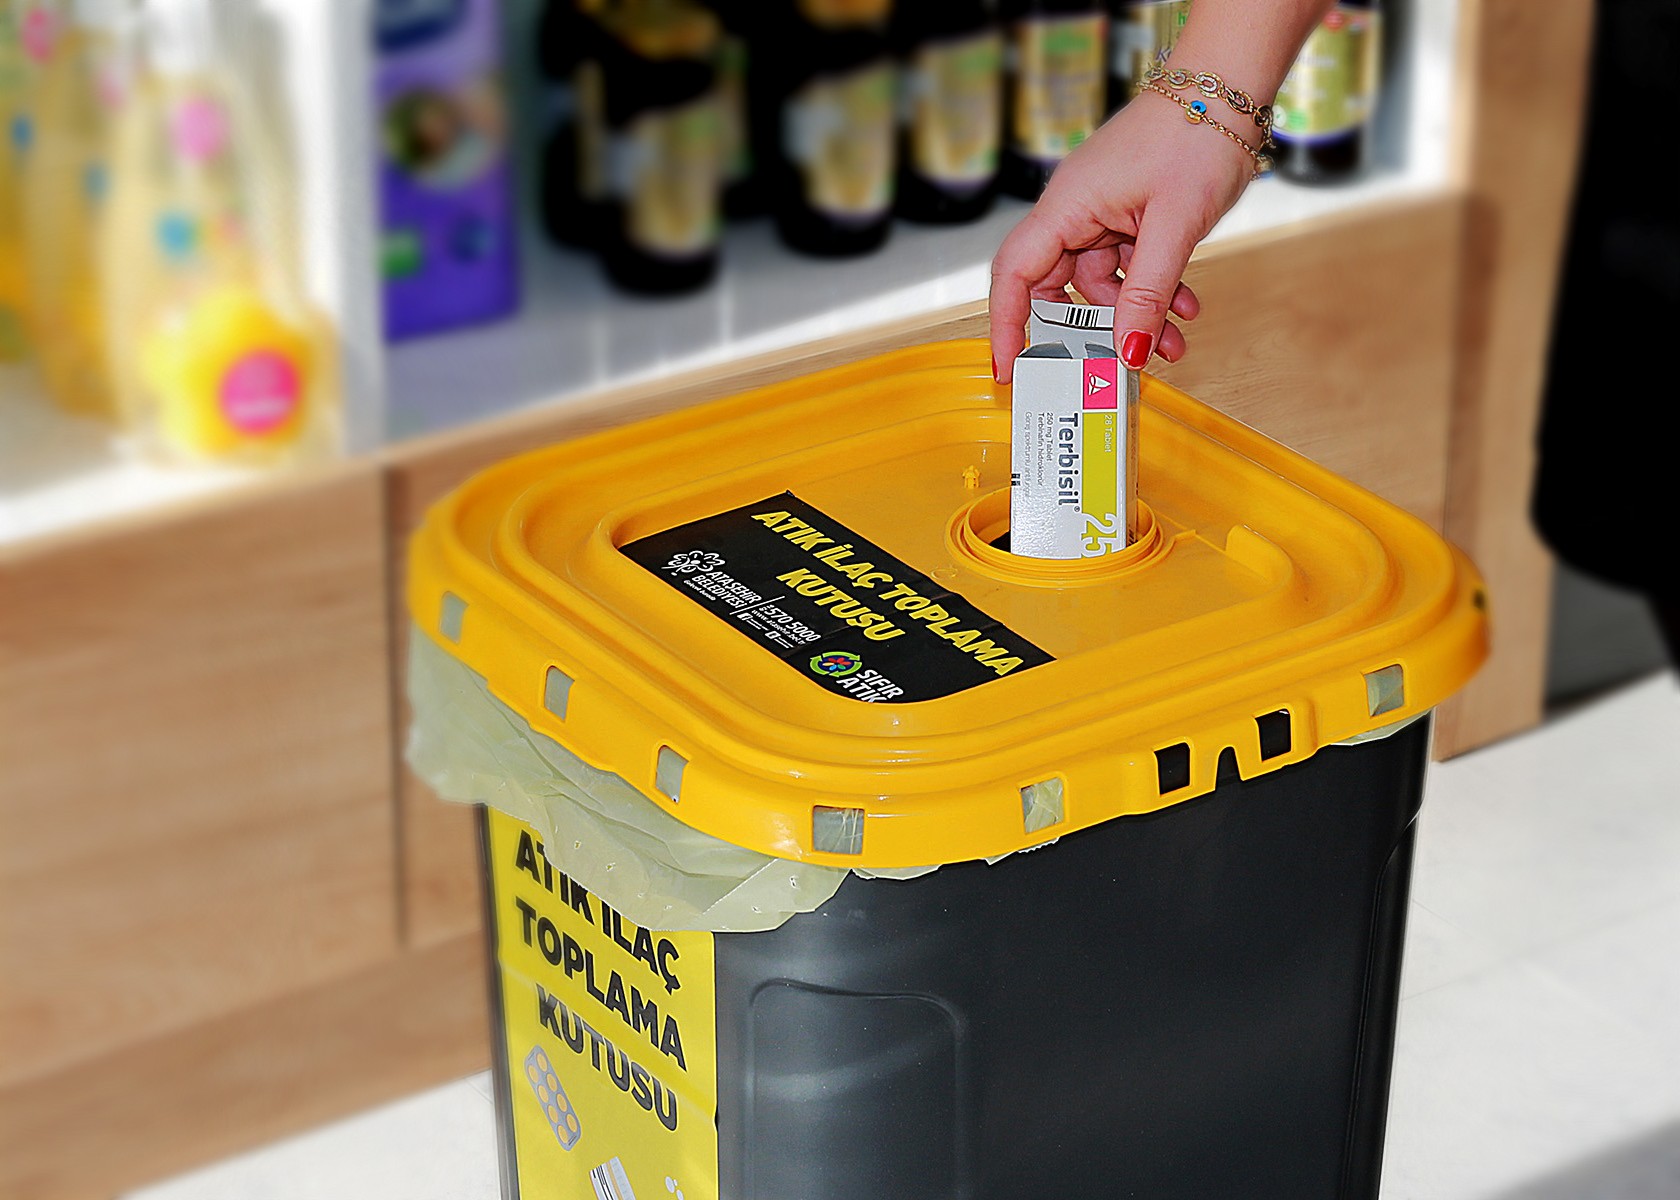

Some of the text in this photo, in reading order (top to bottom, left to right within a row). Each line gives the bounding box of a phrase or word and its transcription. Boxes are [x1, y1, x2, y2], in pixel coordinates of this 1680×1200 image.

[1104, 428, 1113, 453] Tablet
[751, 510, 1024, 676] ATIK İLAÇ TOPLAMA
[764, 607, 794, 623] 570
[785, 621, 821, 642] 5000
[776, 568, 906, 641] KUTUSU
[836, 677, 887, 703] ATIK
[856, 669, 904, 699] SIFIR
[515, 829, 595, 926] ATIK
[515, 895, 687, 1072] TOPLAMA
[536, 982, 678, 1131] KUTUSU
